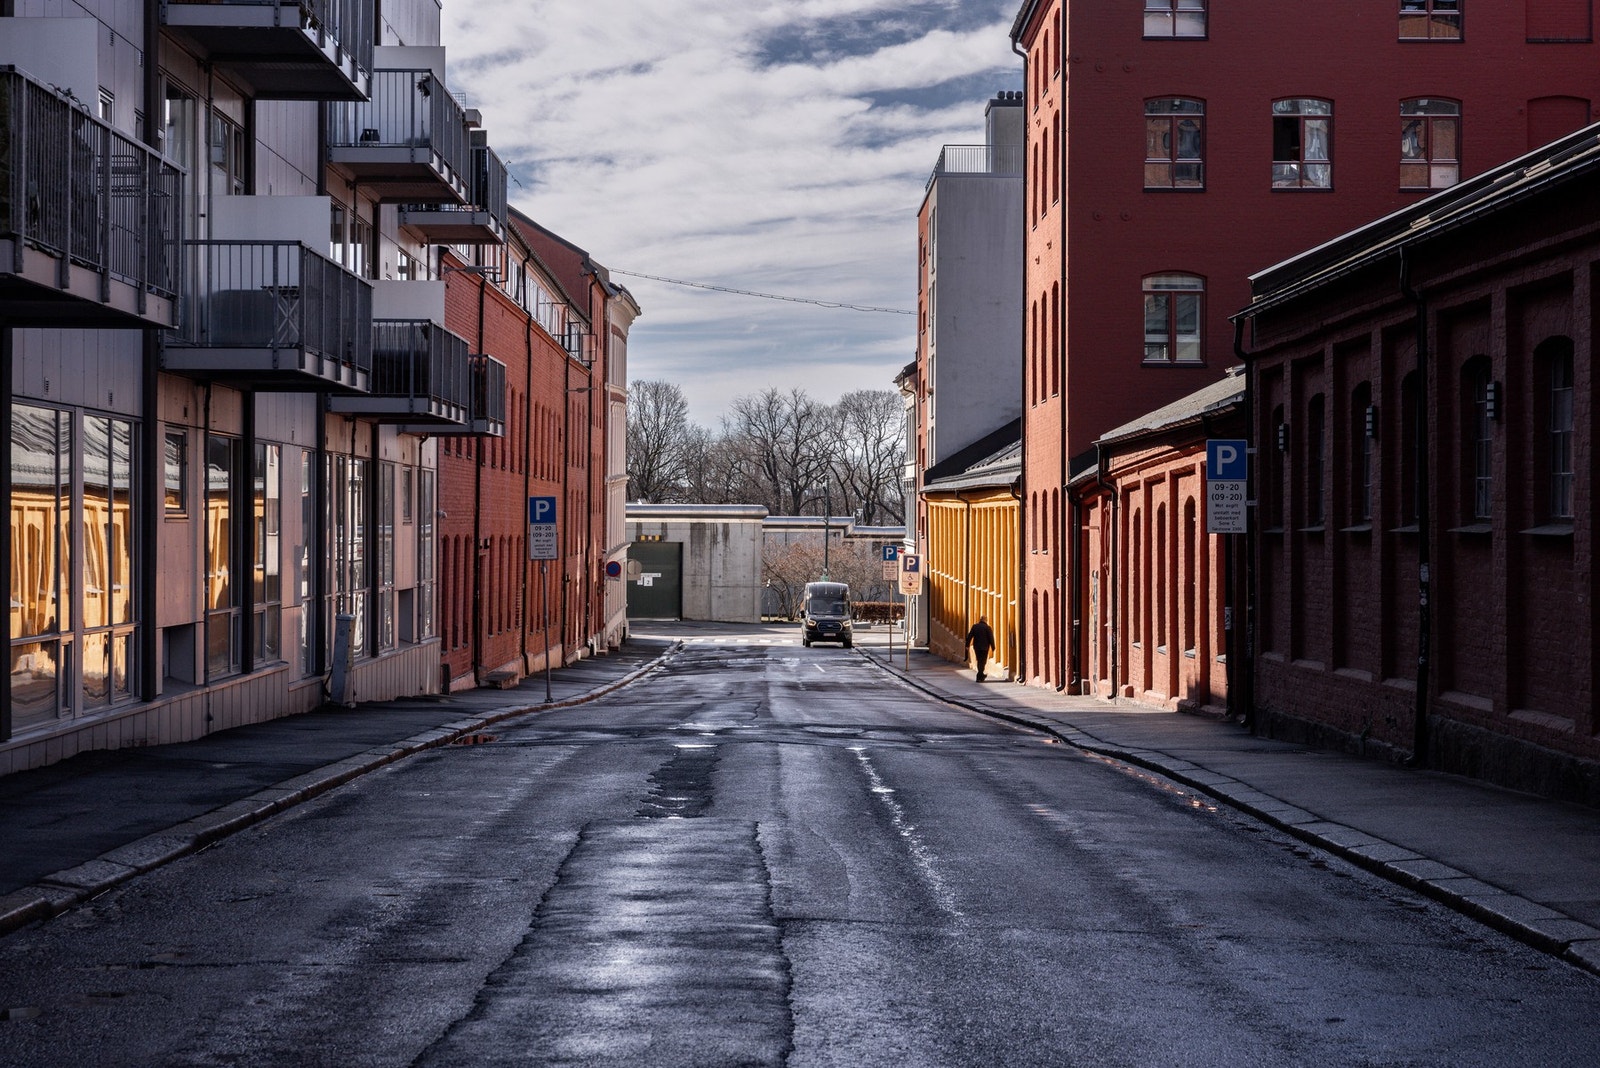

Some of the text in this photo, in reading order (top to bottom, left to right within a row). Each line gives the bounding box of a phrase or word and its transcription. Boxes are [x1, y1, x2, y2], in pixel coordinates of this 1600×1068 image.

[1217, 445, 1237, 475] P
[535, 500, 550, 520] P
[886, 548, 894, 559] P
[907, 557, 916, 570] P
